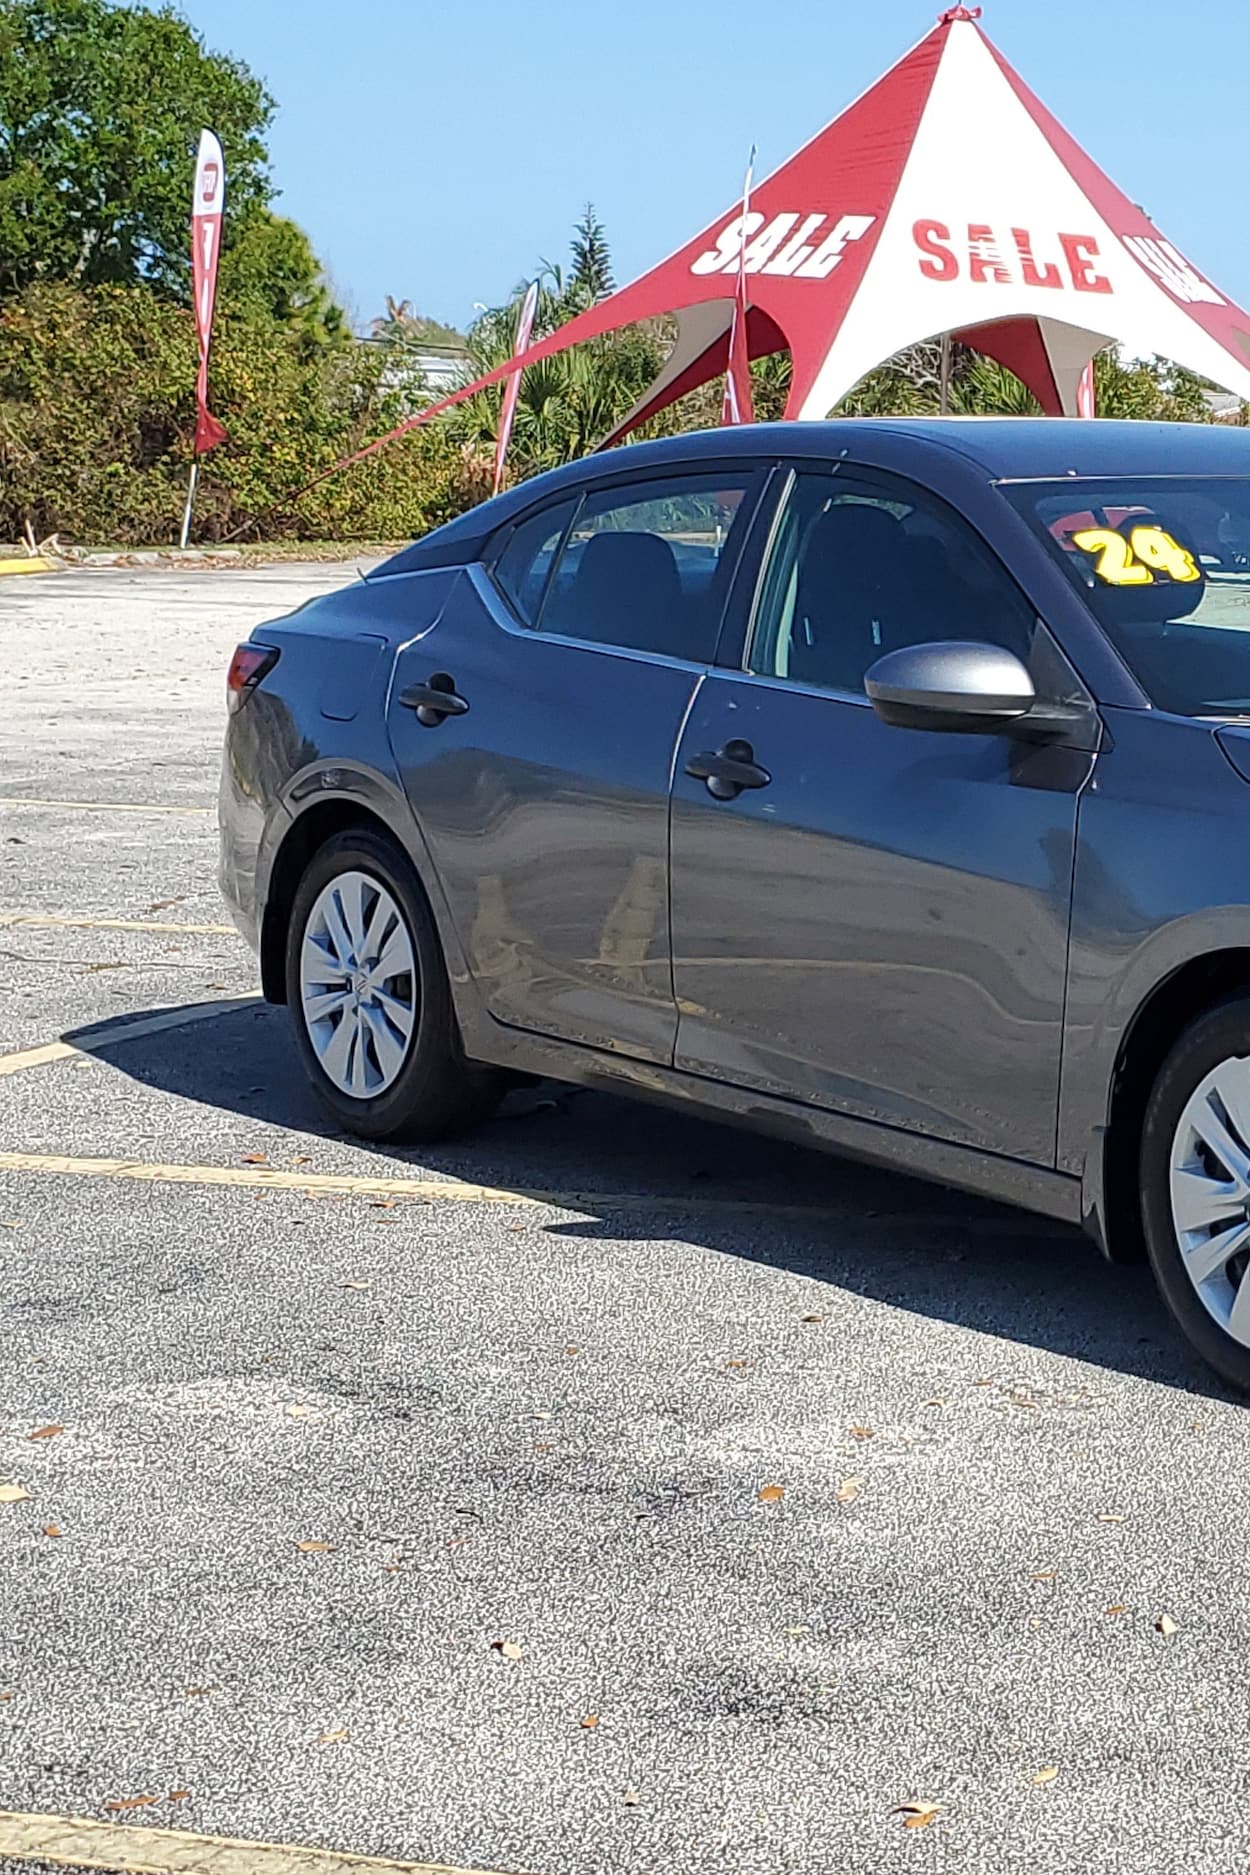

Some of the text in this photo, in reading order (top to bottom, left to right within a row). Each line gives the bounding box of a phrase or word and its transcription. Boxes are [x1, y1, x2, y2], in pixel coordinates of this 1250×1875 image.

[690, 212, 876, 278] SALE
[911, 219, 1114, 294] SALE
[1073, 526, 1200, 585] 24
